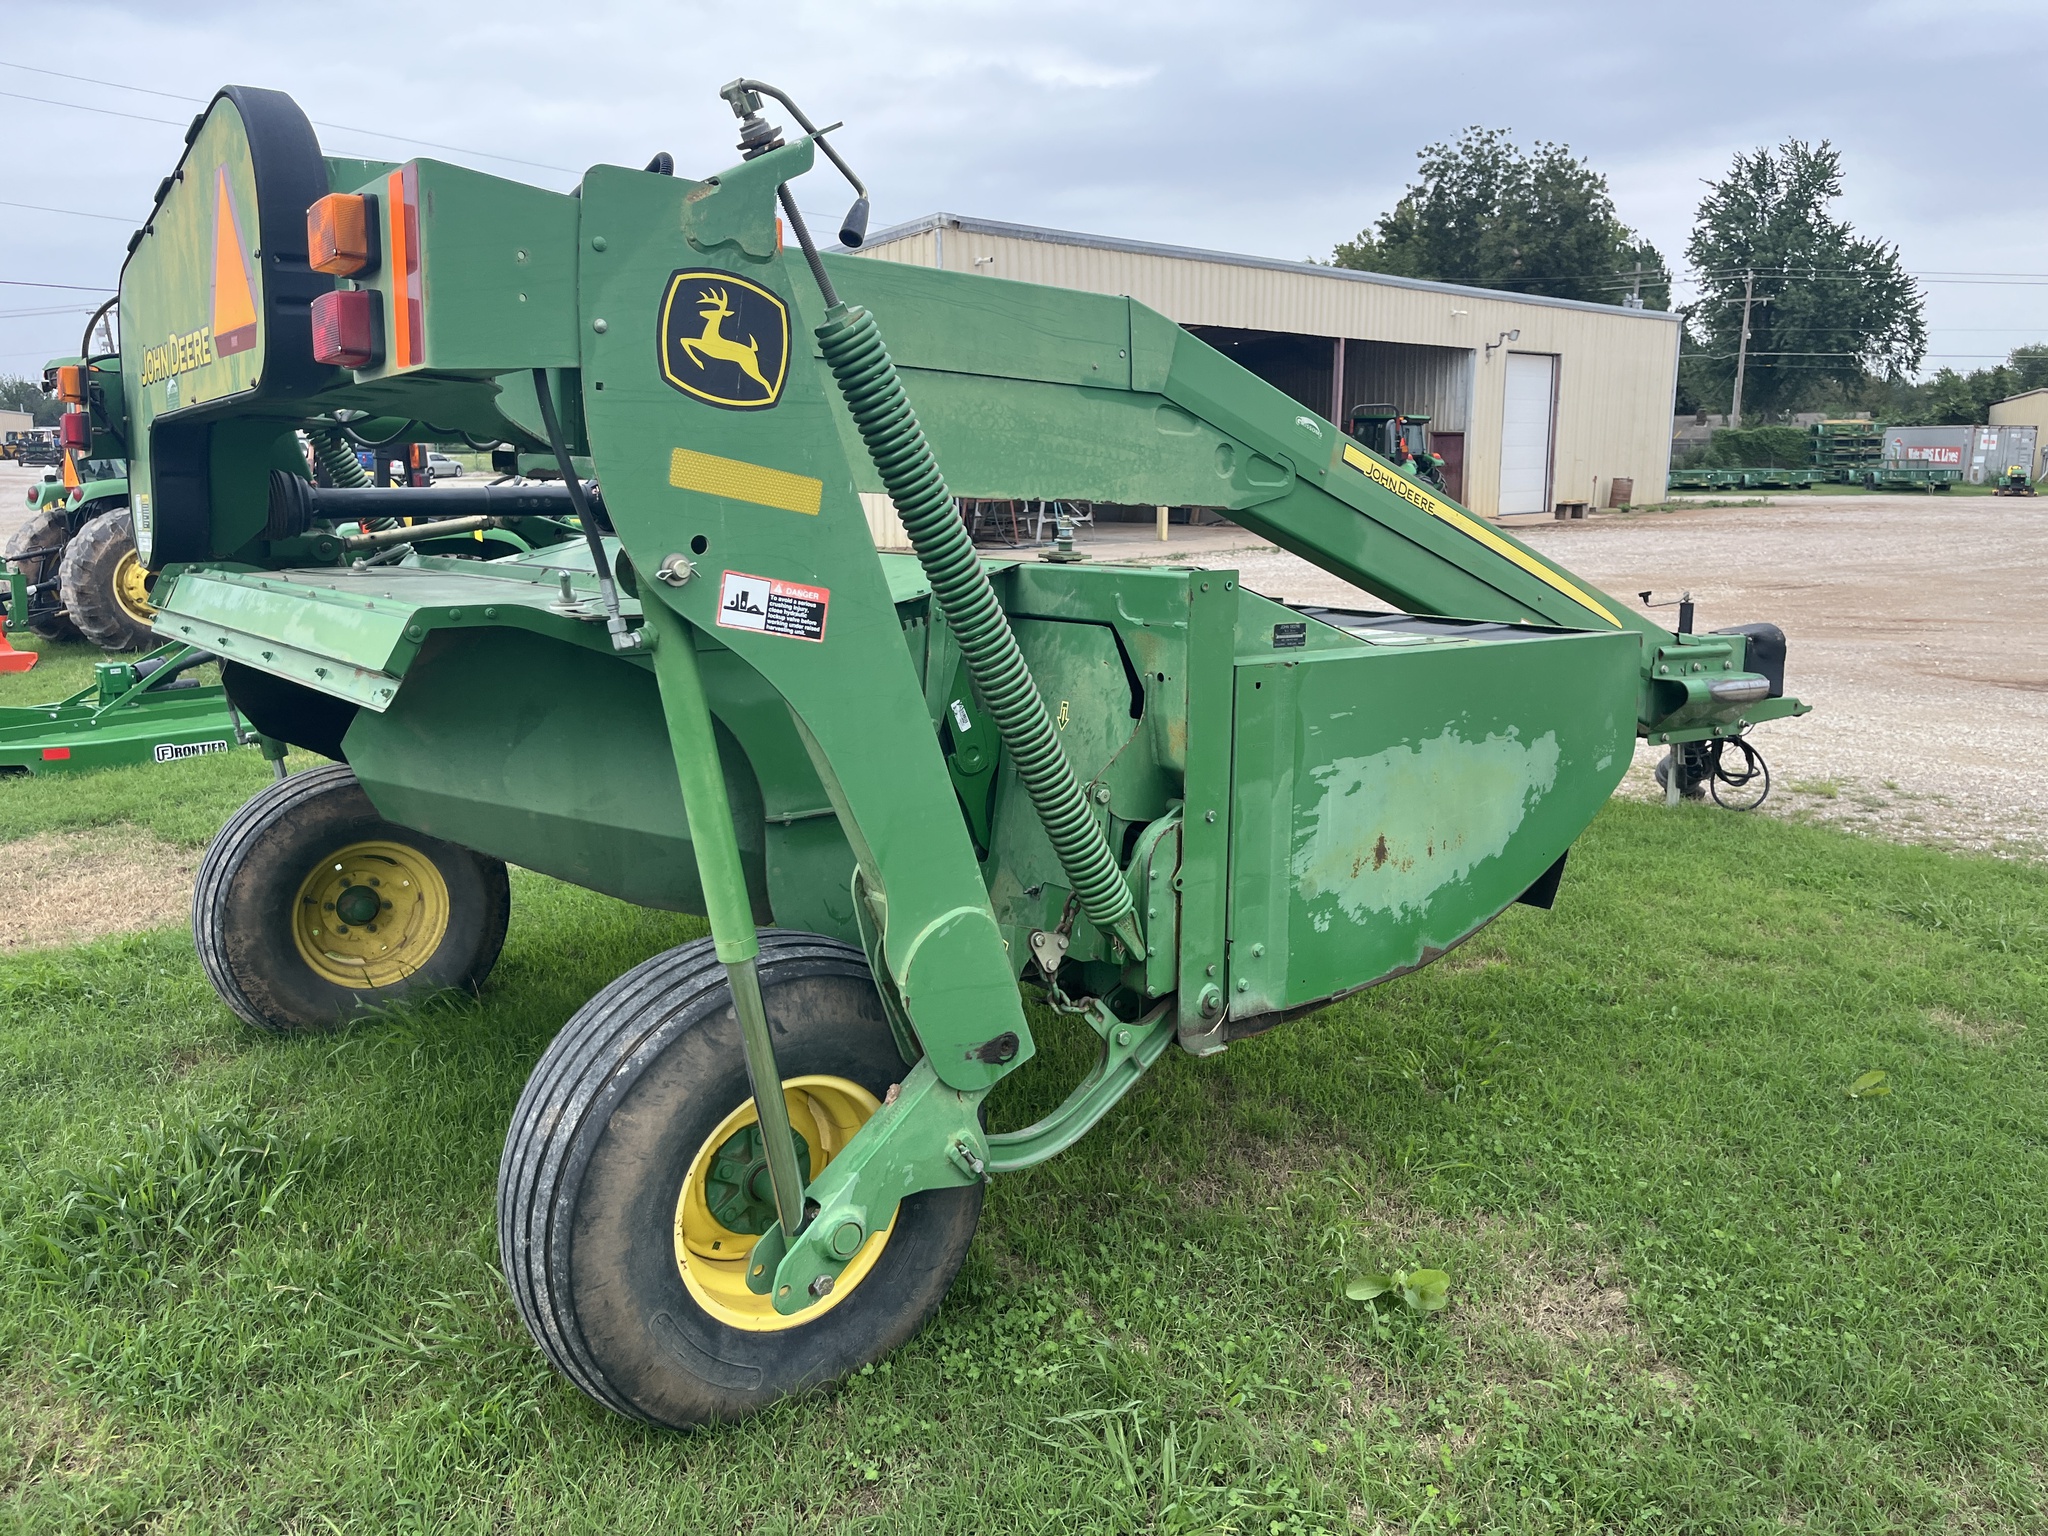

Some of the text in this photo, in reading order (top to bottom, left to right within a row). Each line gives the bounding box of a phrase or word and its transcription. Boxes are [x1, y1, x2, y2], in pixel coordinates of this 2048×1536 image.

[142, 324, 212, 388] JOHN DEERE
[1366, 463, 1435, 513] JOHN DEERE
[786, 588, 819, 600] DANGER
[769, 602, 792, 610] crushing
[798, 600, 816, 608] serious
[767, 613, 785, 621] lockup
[784, 609, 807, 618] hydraulic
[767, 619, 788, 628] working
[766, 624, 793, 634] harvesting
[156, 741, 227, 762] FRONTIER
